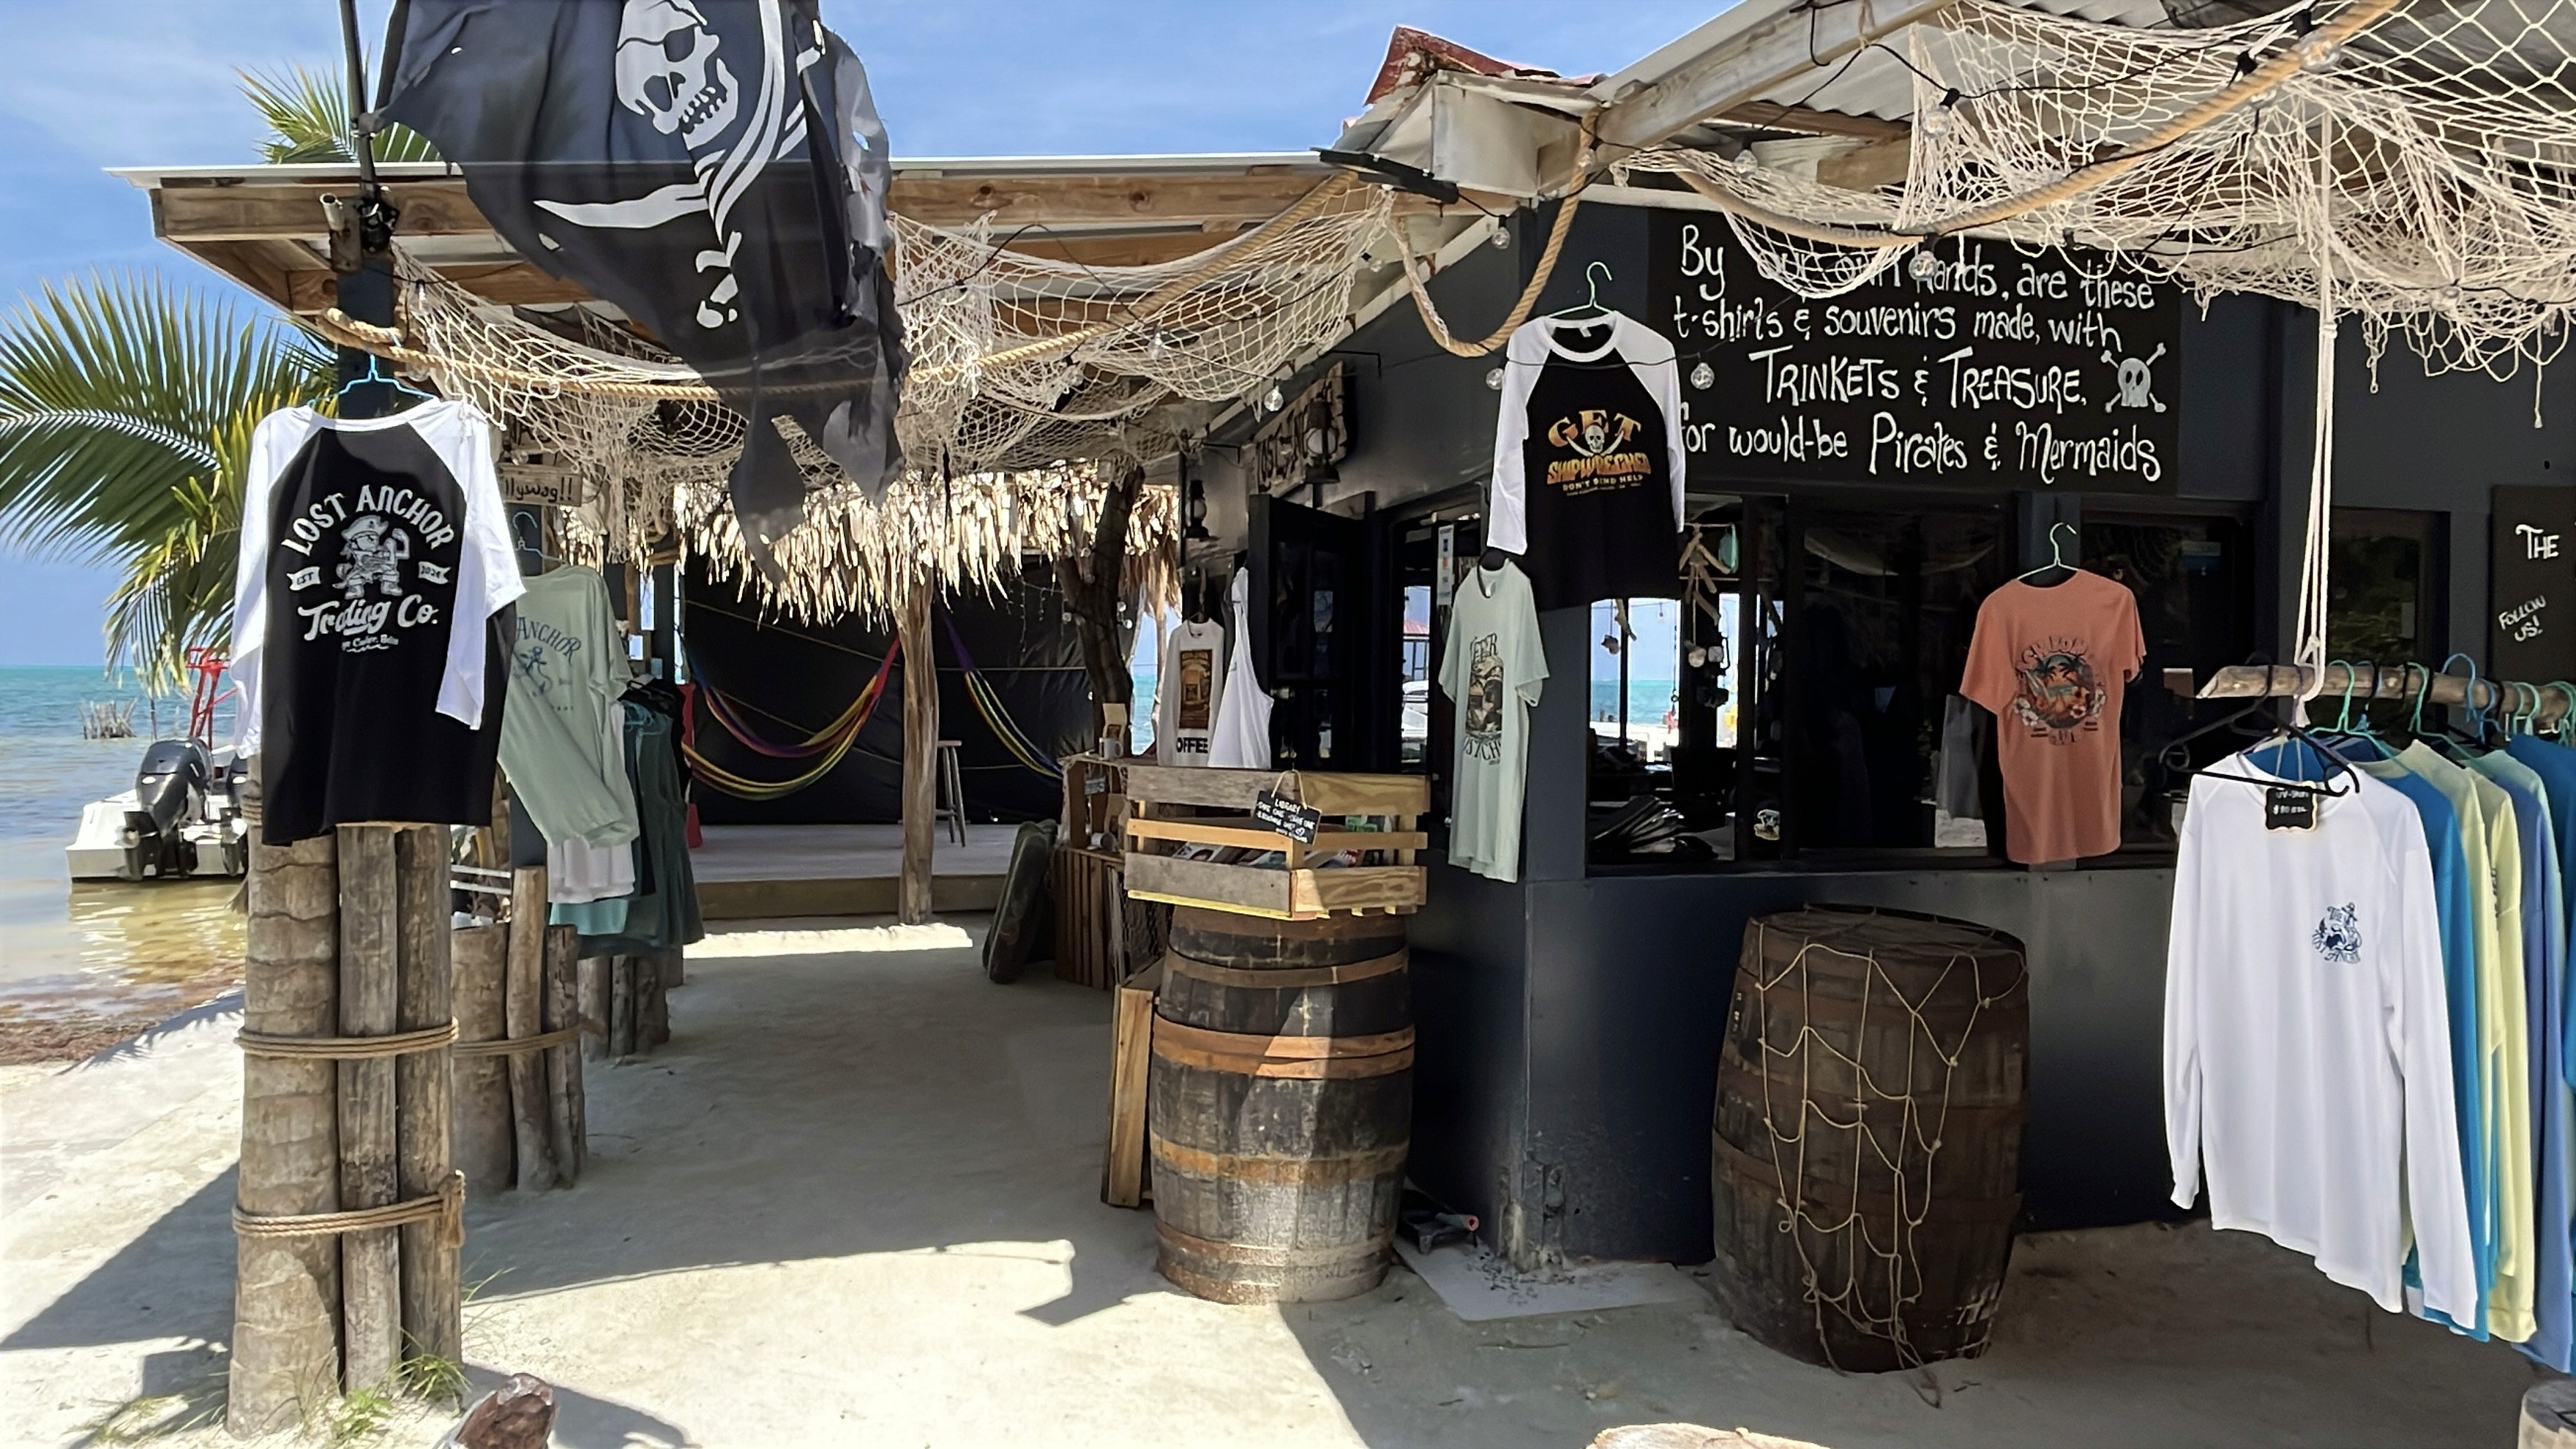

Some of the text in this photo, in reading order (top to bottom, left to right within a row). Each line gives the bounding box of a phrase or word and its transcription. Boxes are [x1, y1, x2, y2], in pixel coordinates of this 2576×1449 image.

[1681, 224, 1724, 301] By
[2016, 263, 2068, 299] are
[2080, 259, 2155, 310] these
[1674, 296, 1783, 342] t-shirts
[1824, 302, 1955, 340] souvenirs
[1974, 303, 2040, 345] made,
[2048, 310, 2122, 352] with
[1748, 345, 1901, 406] TRINKETS
[1548, 410, 1641, 447] GET
[1729, 415, 1848, 463] would-be
[1869, 411, 1968, 474] Pirates
[2015, 421, 2161, 484] Mermaids
[281, 484, 454, 557] LOST ANCHOR
[2515, 524, 2560, 560] THE
[297, 594, 439, 641] Trading Co.
[2498, 595, 2547, 630] FOLLOW
[2514, 614, 2544, 642] US!
[514, 617, 583, 665] ANCHOR
